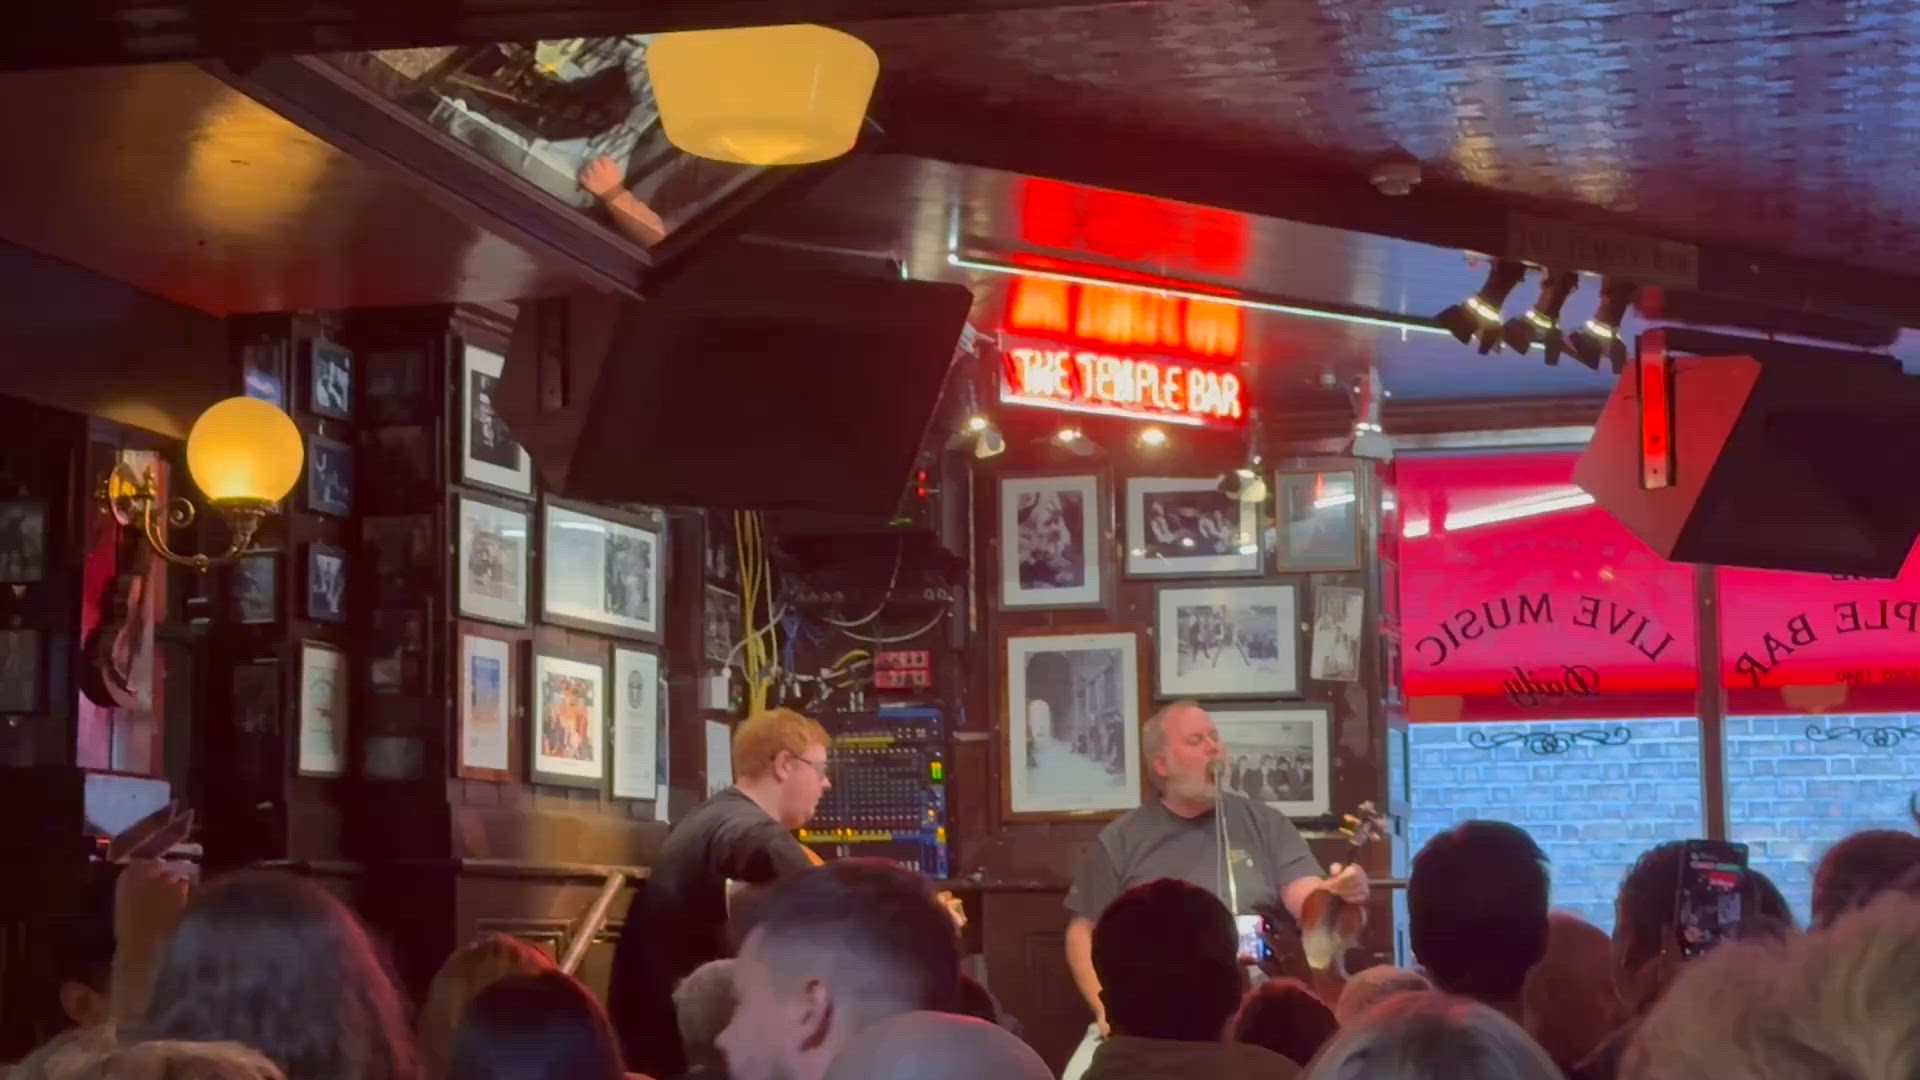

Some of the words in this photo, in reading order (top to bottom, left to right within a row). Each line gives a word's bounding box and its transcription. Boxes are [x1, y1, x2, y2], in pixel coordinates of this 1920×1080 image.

[1012, 348, 1072, 396] THE
[1075, 353, 1183, 411] TEMPLE
[1187, 367, 1241, 419] BAR
